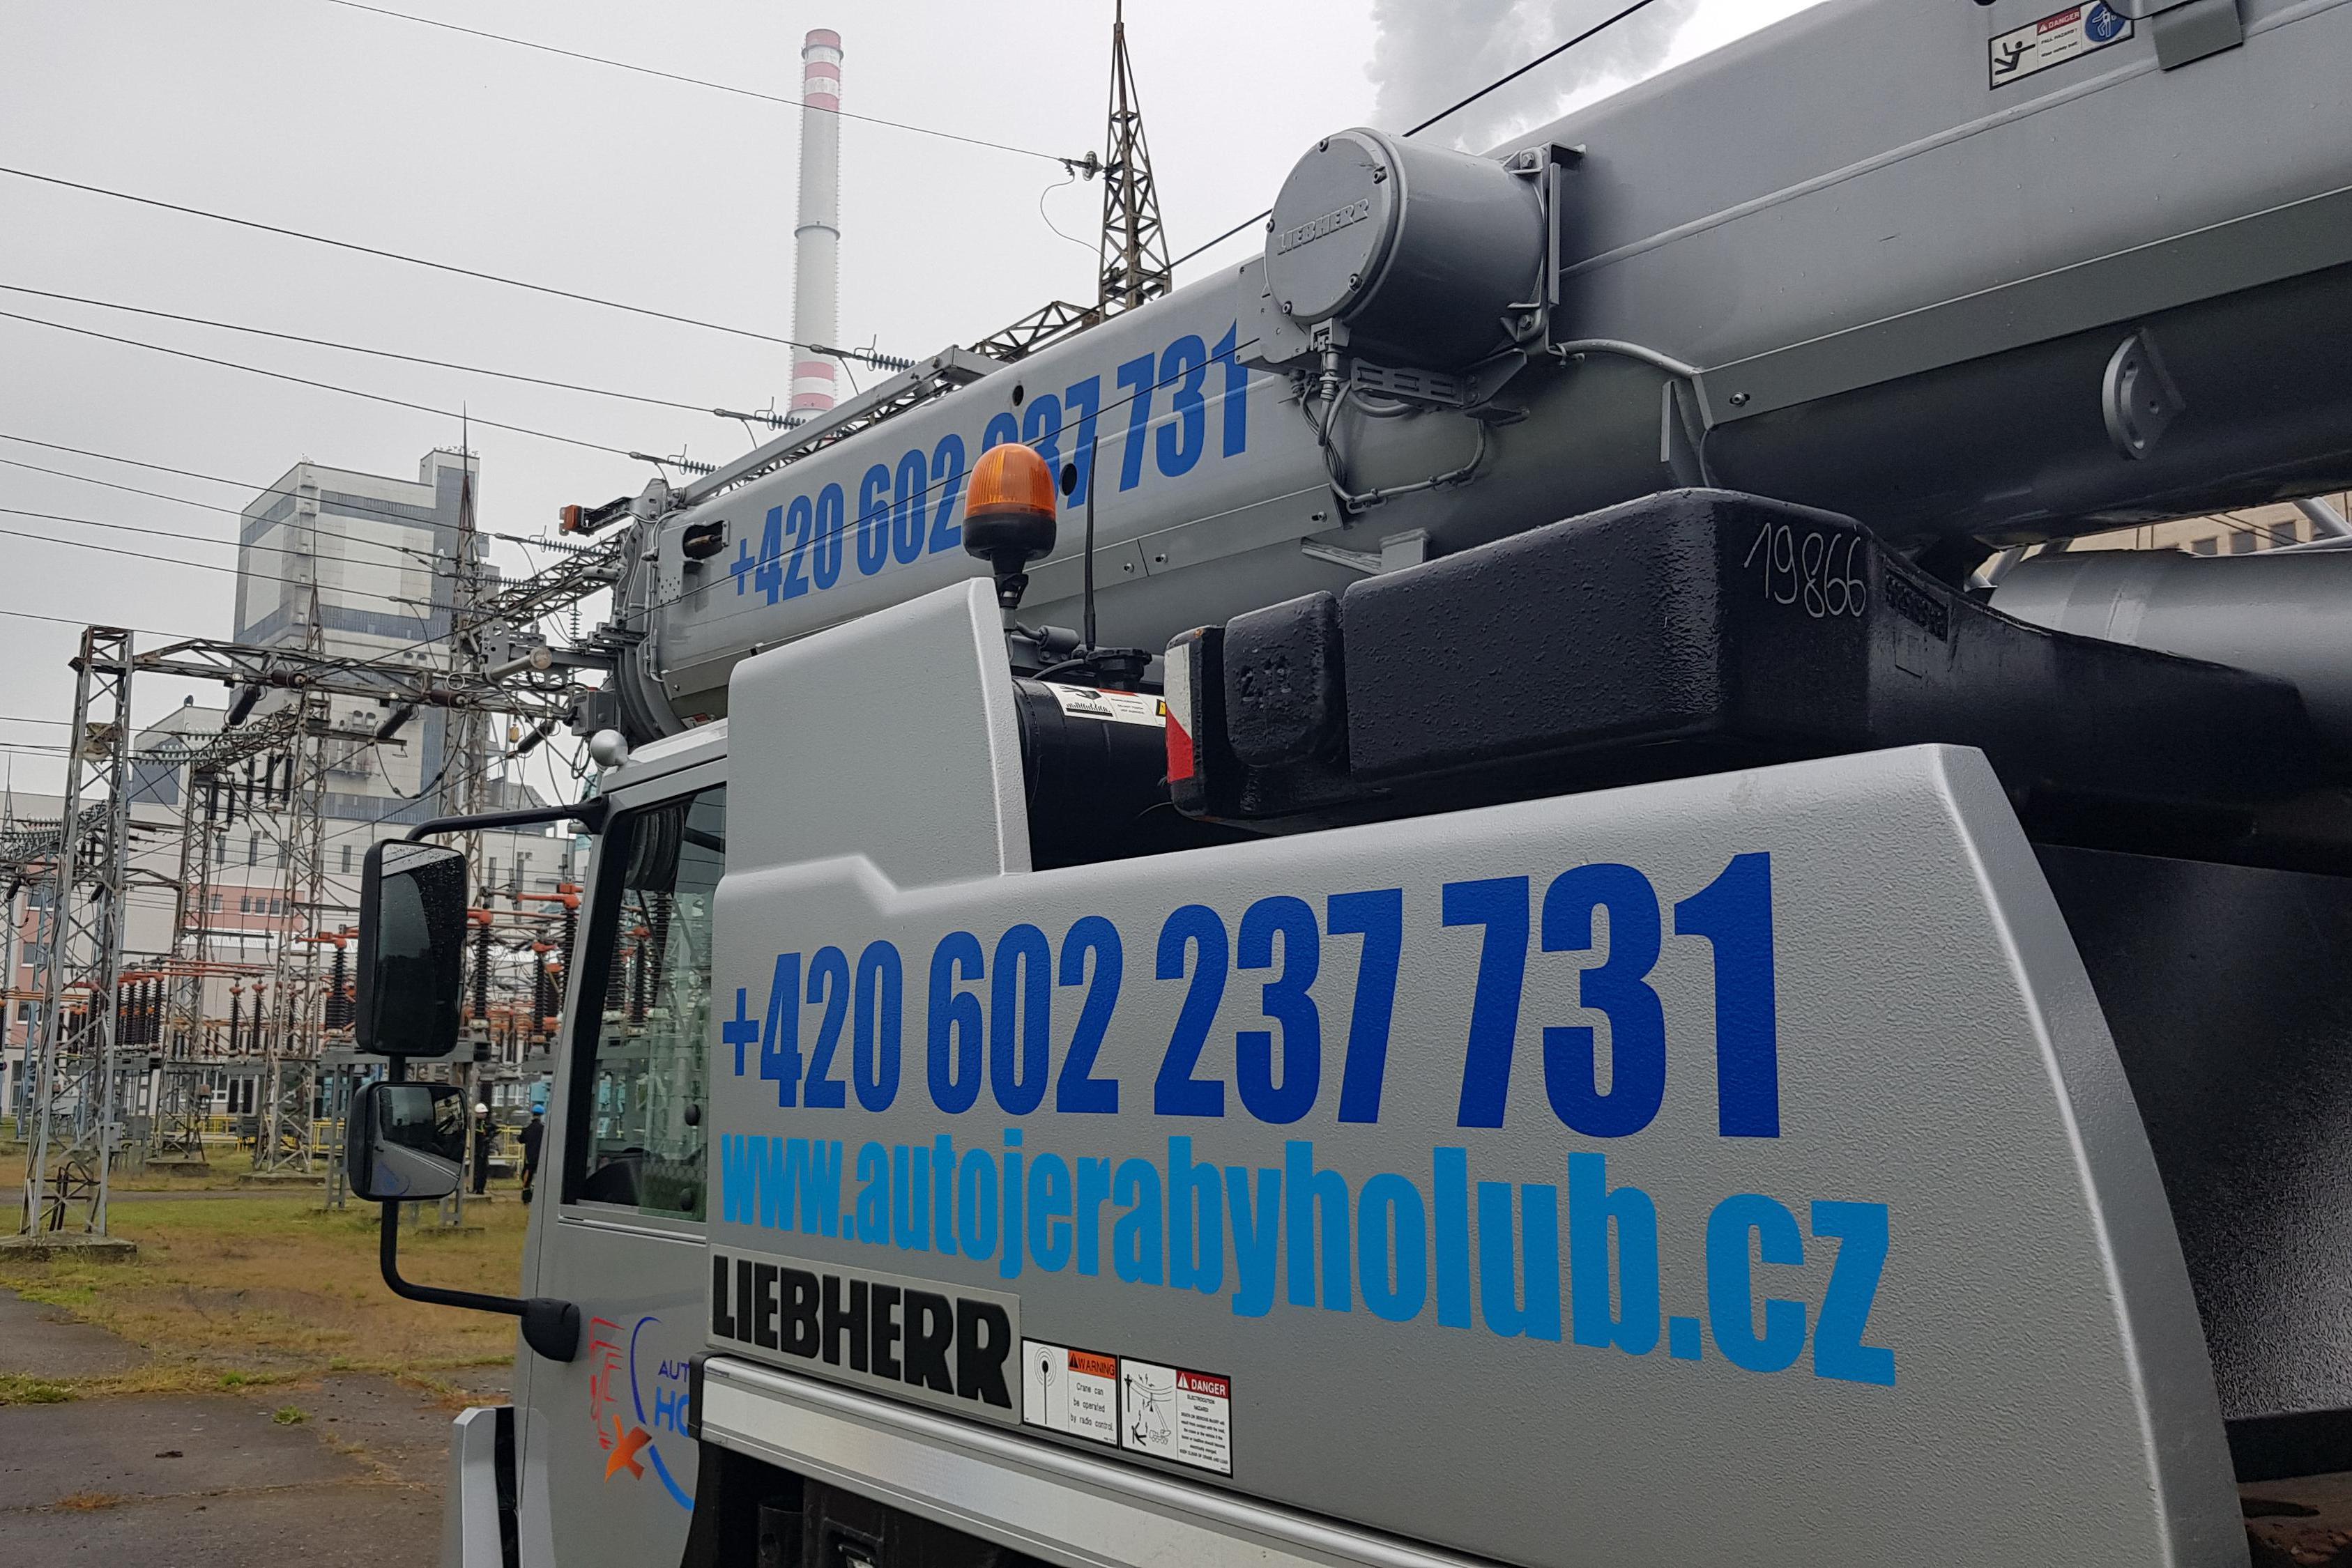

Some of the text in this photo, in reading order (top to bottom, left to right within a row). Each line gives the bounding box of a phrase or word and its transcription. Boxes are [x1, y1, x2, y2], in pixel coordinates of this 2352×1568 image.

[2048, 11, 2079, 29] DANGER
[1277, 199, 1370, 255] LIEBHERR
[730, 482, 845, 605] +420
[857, 434, 966, 564] 602
[1117, 318, 1249, 492] 731
[1744, 522, 1867, 618] 19866
[722, 851, 1780, 1138] +420 602 237 731
[721, 1127, 1897, 1388] www.autojerabyholub.cz
[712, 1254, 1012, 1410] LIEBHERR
[1078, 1357, 1115, 1376] WARNING
[1074, 1397, 1105, 1413] be operated
[1076, 1382, 1104, 1396] Crane can
[1191, 1378, 1226, 1396] DANGER
[1079, 1417, 1092, 1426] radio
